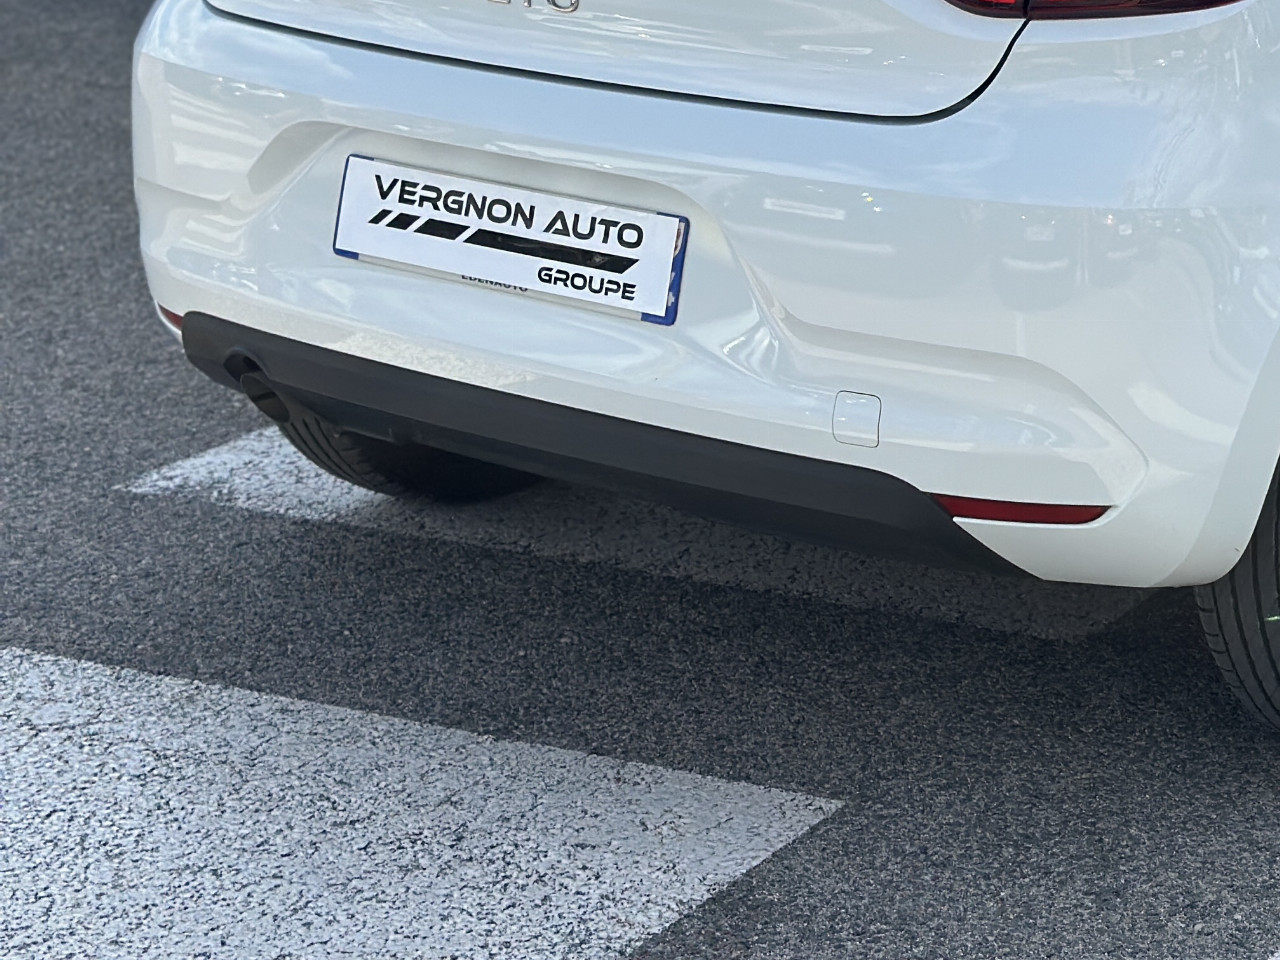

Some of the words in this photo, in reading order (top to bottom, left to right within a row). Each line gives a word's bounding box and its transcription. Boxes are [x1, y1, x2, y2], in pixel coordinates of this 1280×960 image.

[374, 174, 536, 230] VERGNON
[542, 208, 645, 250] AUTO
[537, 266, 637, 302] GROUPE
